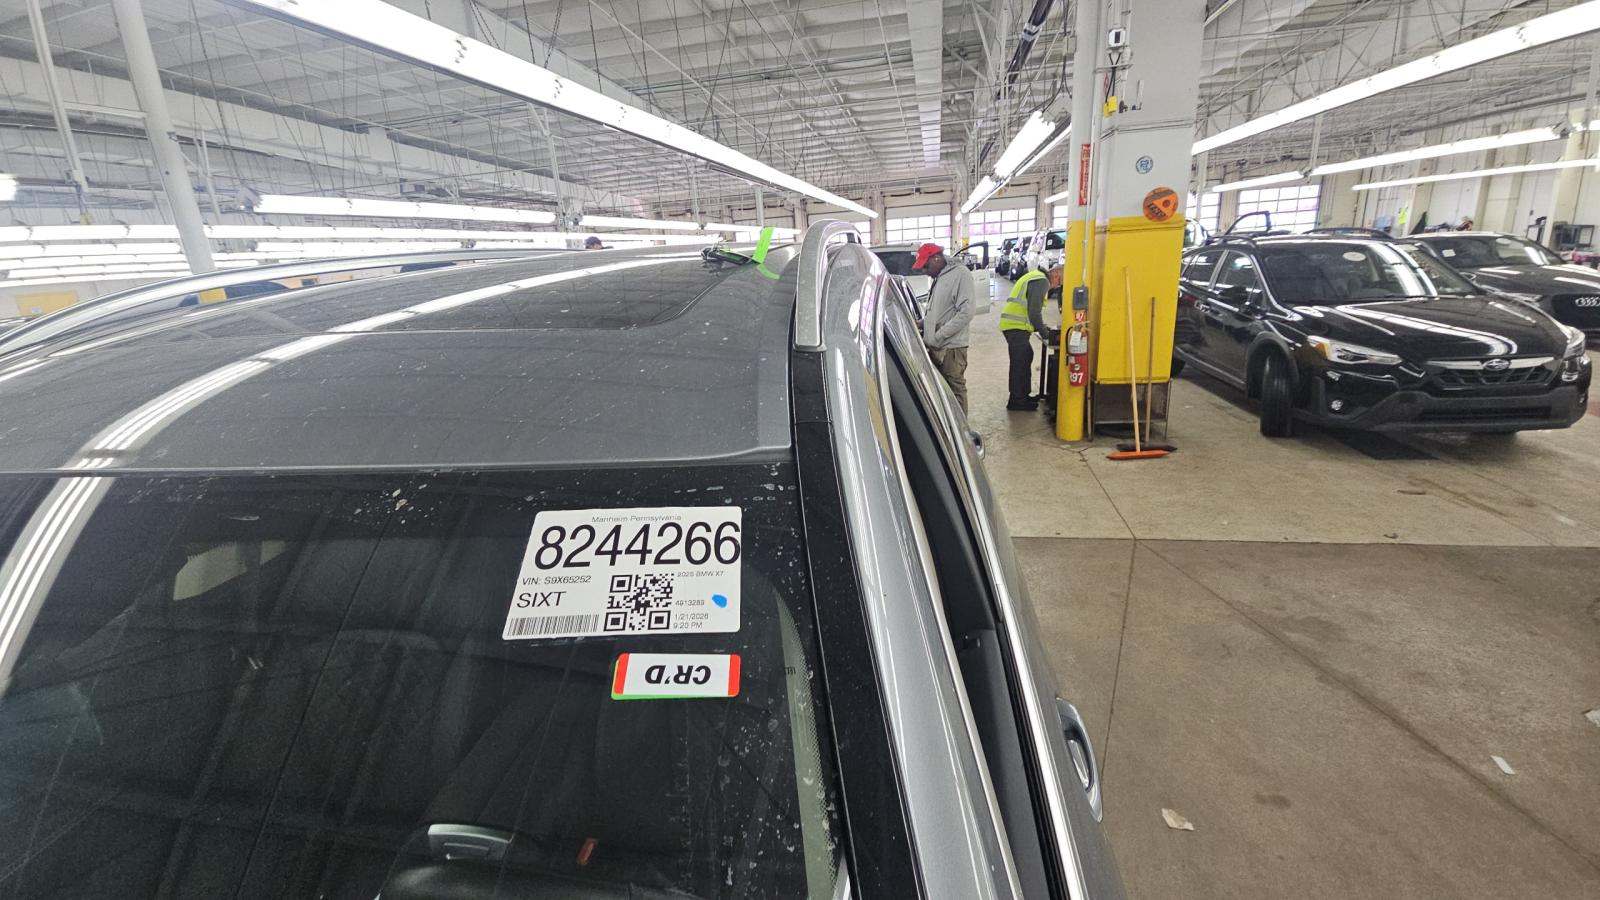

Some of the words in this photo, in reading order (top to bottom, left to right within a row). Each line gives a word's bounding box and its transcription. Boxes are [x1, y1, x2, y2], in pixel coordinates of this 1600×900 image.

[592, 515, 628, 523] Manheim
[630, 514, 682, 522] Pennsylvania
[534, 521, 741, 570] 8244266
[522, 577, 541, 586] VIN:
[544, 575, 592, 585] S9X65252
[516, 591, 567, 609] SIXT
[690, 621, 703, 629] PM
[645, 664, 712, 685] CR'D
